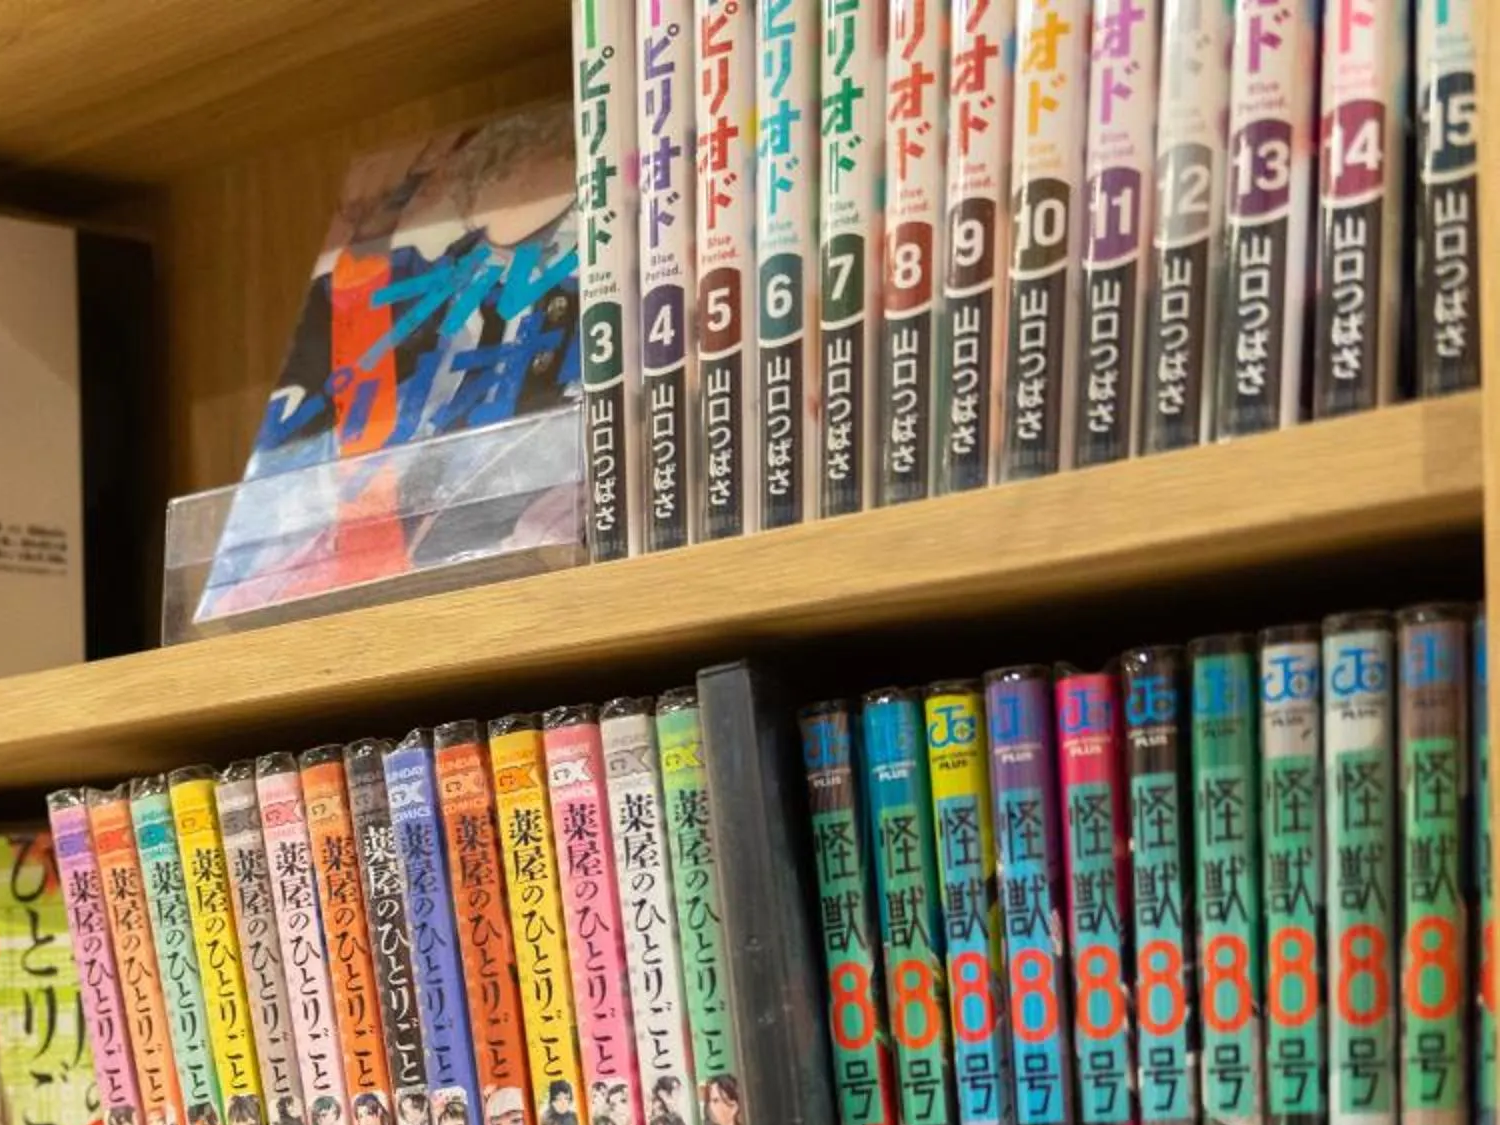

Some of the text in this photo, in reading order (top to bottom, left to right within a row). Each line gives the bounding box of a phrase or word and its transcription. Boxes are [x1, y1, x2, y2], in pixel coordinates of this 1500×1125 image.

[821, 0, 864, 196] リオド
[1232, 132, 1290, 195] 13
[1322, 118, 1384, 181] 14
[1422, 94, 1477, 151] 15
[765, 273, 793, 319] 6
[828, 252, 855, 301] 7
[891, 241, 922, 290] 8
[953, 218, 985, 267] 9
[1013, 197, 1066, 248] 10
[1090, 185, 1134, 240] 11
[1331, 216, 1367, 380] 山口つばさ
[1433, 189, 1469, 358] 山口つばさ
[589, 321, 613, 363] 3
[648, 304, 675, 346] 4
[706, 287, 732, 332] 5
[891, 327, 919, 473] 山口つばさ
[952, 305, 980, 454] 山口つばさ
[1017, 288, 1048, 440] 山口つばさ
[1088, 279, 1121, 433] 山口つばさ
[1158, 256, 1192, 415] 山口つばさ
[1236, 235, 1271, 396] 山口つばさ
[591, 398, 616, 531] 山口つばさ
[651, 383, 676, 519] 山口つばさ
[707, 366, 732, 506] 山口つばさ
[767, 355, 792, 496] 山口つばさ
[827, 336, 853, 481] 山口つばさ
[70, 870, 125, 1104] 薬屋のひとりごと
[110, 866, 164, 1103] 薬屋のひとりごと
[151, 860, 209, 1102] 薬屋のひとりごと
[192, 847, 248, 1089] 薬屋のひとりごと
[234, 847, 290, 1095] 薬屋のひとりごと
[276, 841, 331, 1090] 薬屋のひとりごと
[322, 835, 376, 1088] 薬屋のひとりごと
[364, 825, 420, 1088] 薬屋のひとりごと
[403, 823, 454, 1085] 薬屋のひとりごと
[456, 813, 509, 1079] 薬屋のひとりごと
[509, 807, 564, 1077] 薬屋のひとりごと
[562, 803, 617, 1075] 薬屋のひとりごと
[621, 793, 671, 1070] 薬屋のひとりごと
[676, 788, 726, 1071] 薬屋のひとりごと
[818, 821, 878, 1120] 怪獣8号
[880, 815, 943, 1120] 怪獣8号
[939, 806, 999, 1115] 怪獣8号
[1000, 800, 1061, 1116] 怪獣8号
[1069, 793, 1126, 1114] 怪獣8号
[1133, 783, 1187, 1112] 怪獣8号
[1200, 777, 1254, 1110] 怪獣8号
[1266, 766, 1320, 1105] 怪獣8号
[1338, 760, 1391, 1106] 怪獣8号
[1402, 750, 1461, 1102] 怪獣8号
